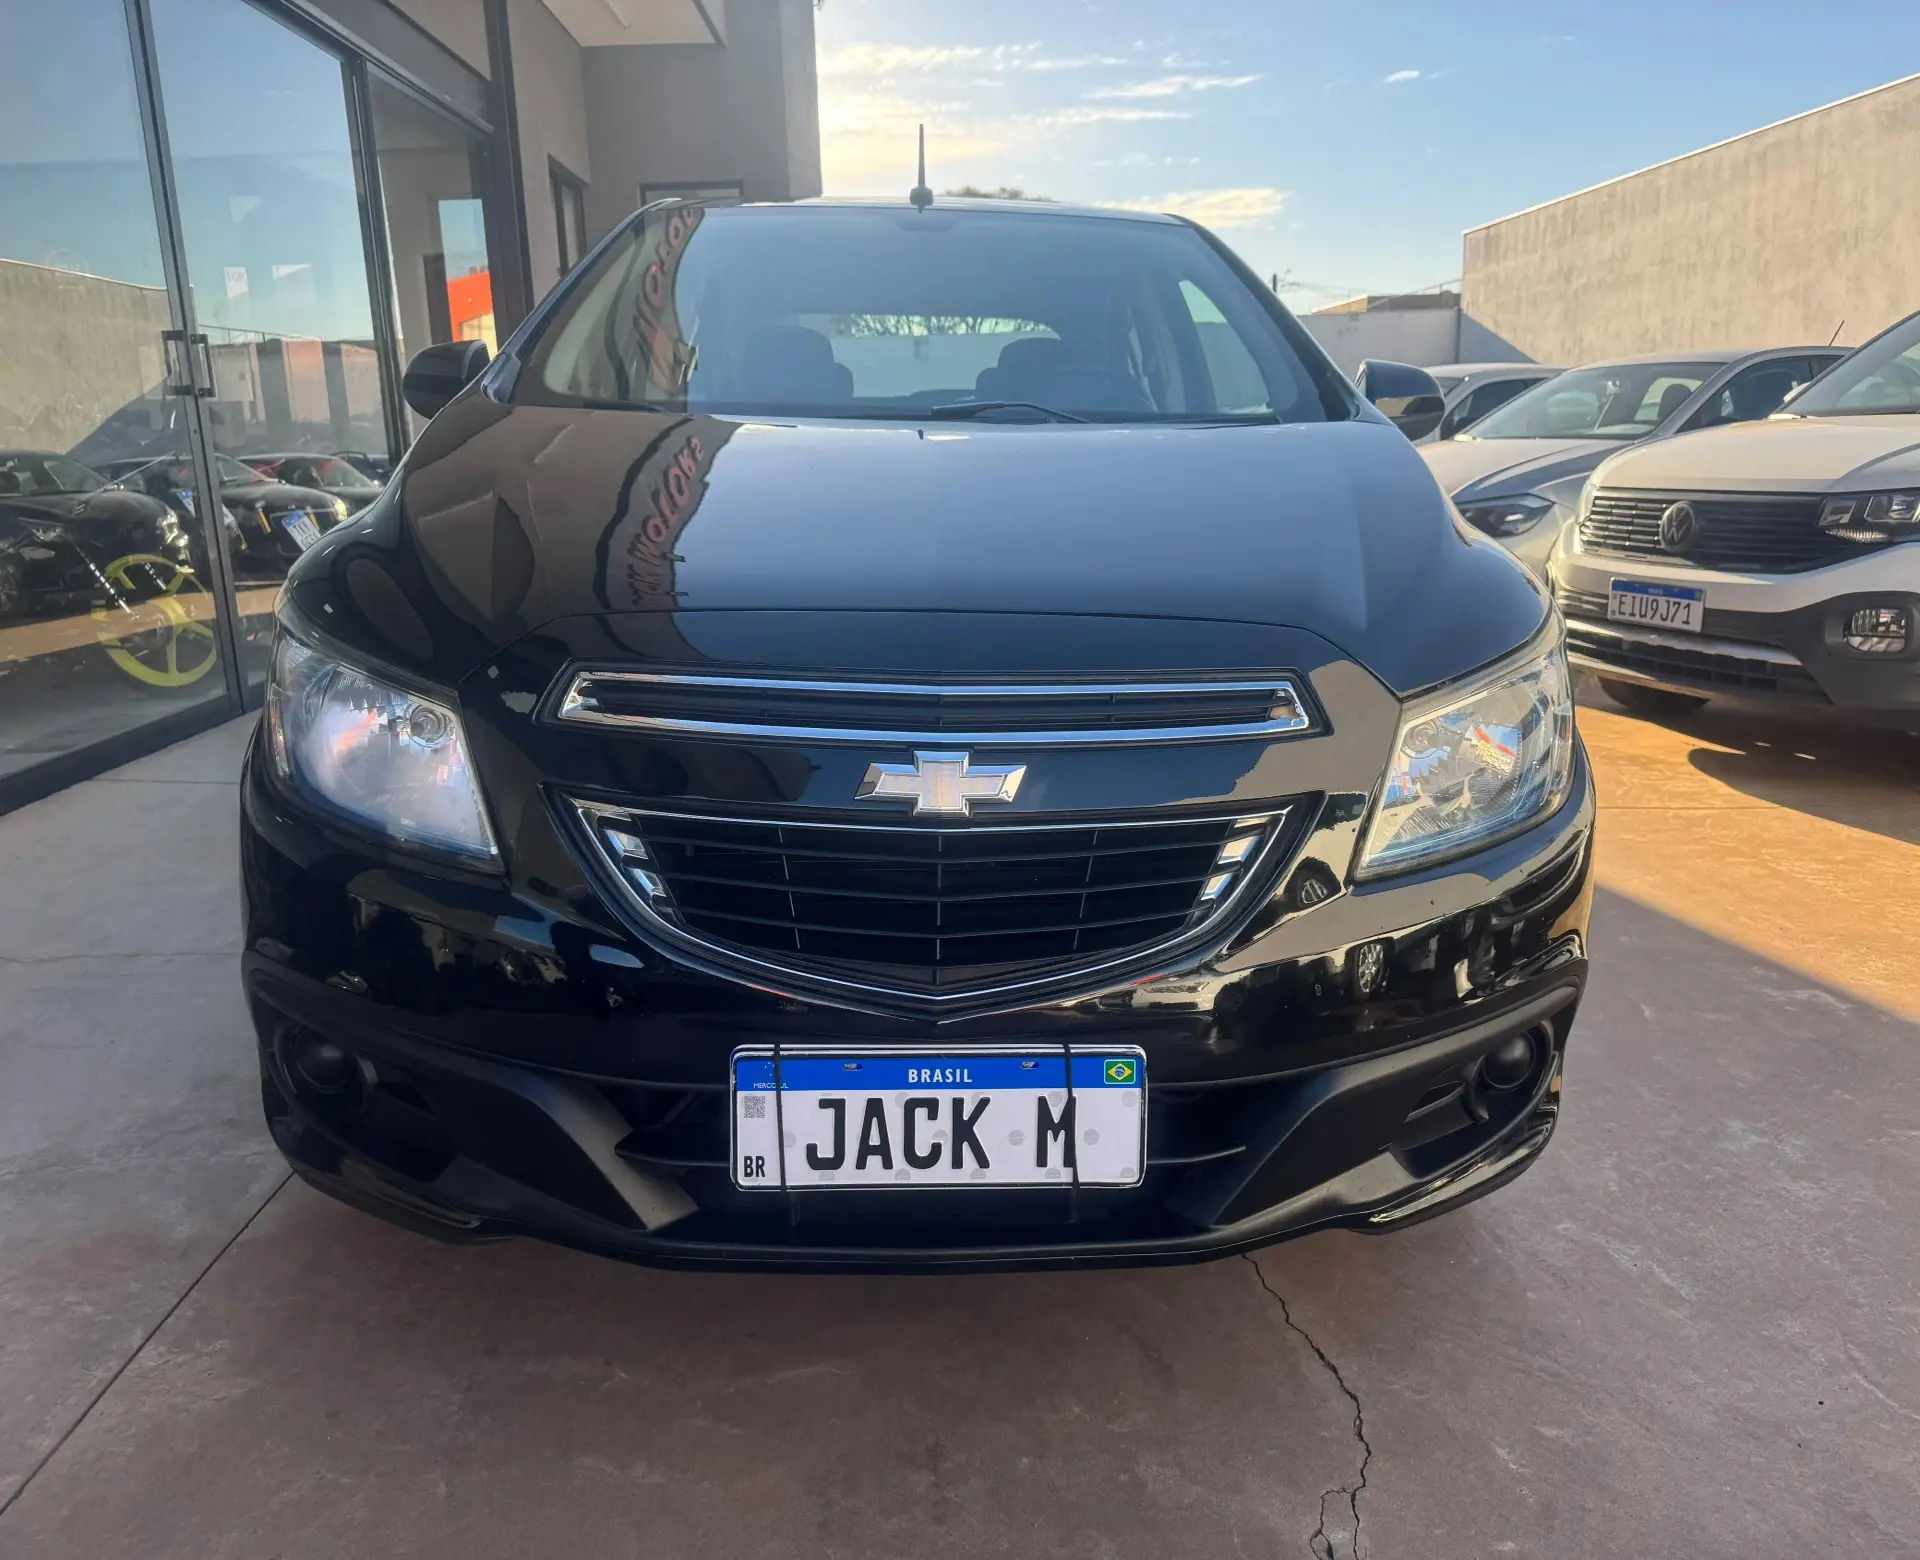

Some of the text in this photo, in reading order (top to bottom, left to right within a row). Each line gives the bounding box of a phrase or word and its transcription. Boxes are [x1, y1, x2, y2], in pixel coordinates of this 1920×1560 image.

[1618, 594, 1691, 625] EIU9J71
[907, 1068, 973, 1083] BRASIL
[805, 1095, 1077, 1171] JACK M
[743, 1155, 767, 1178] BR
